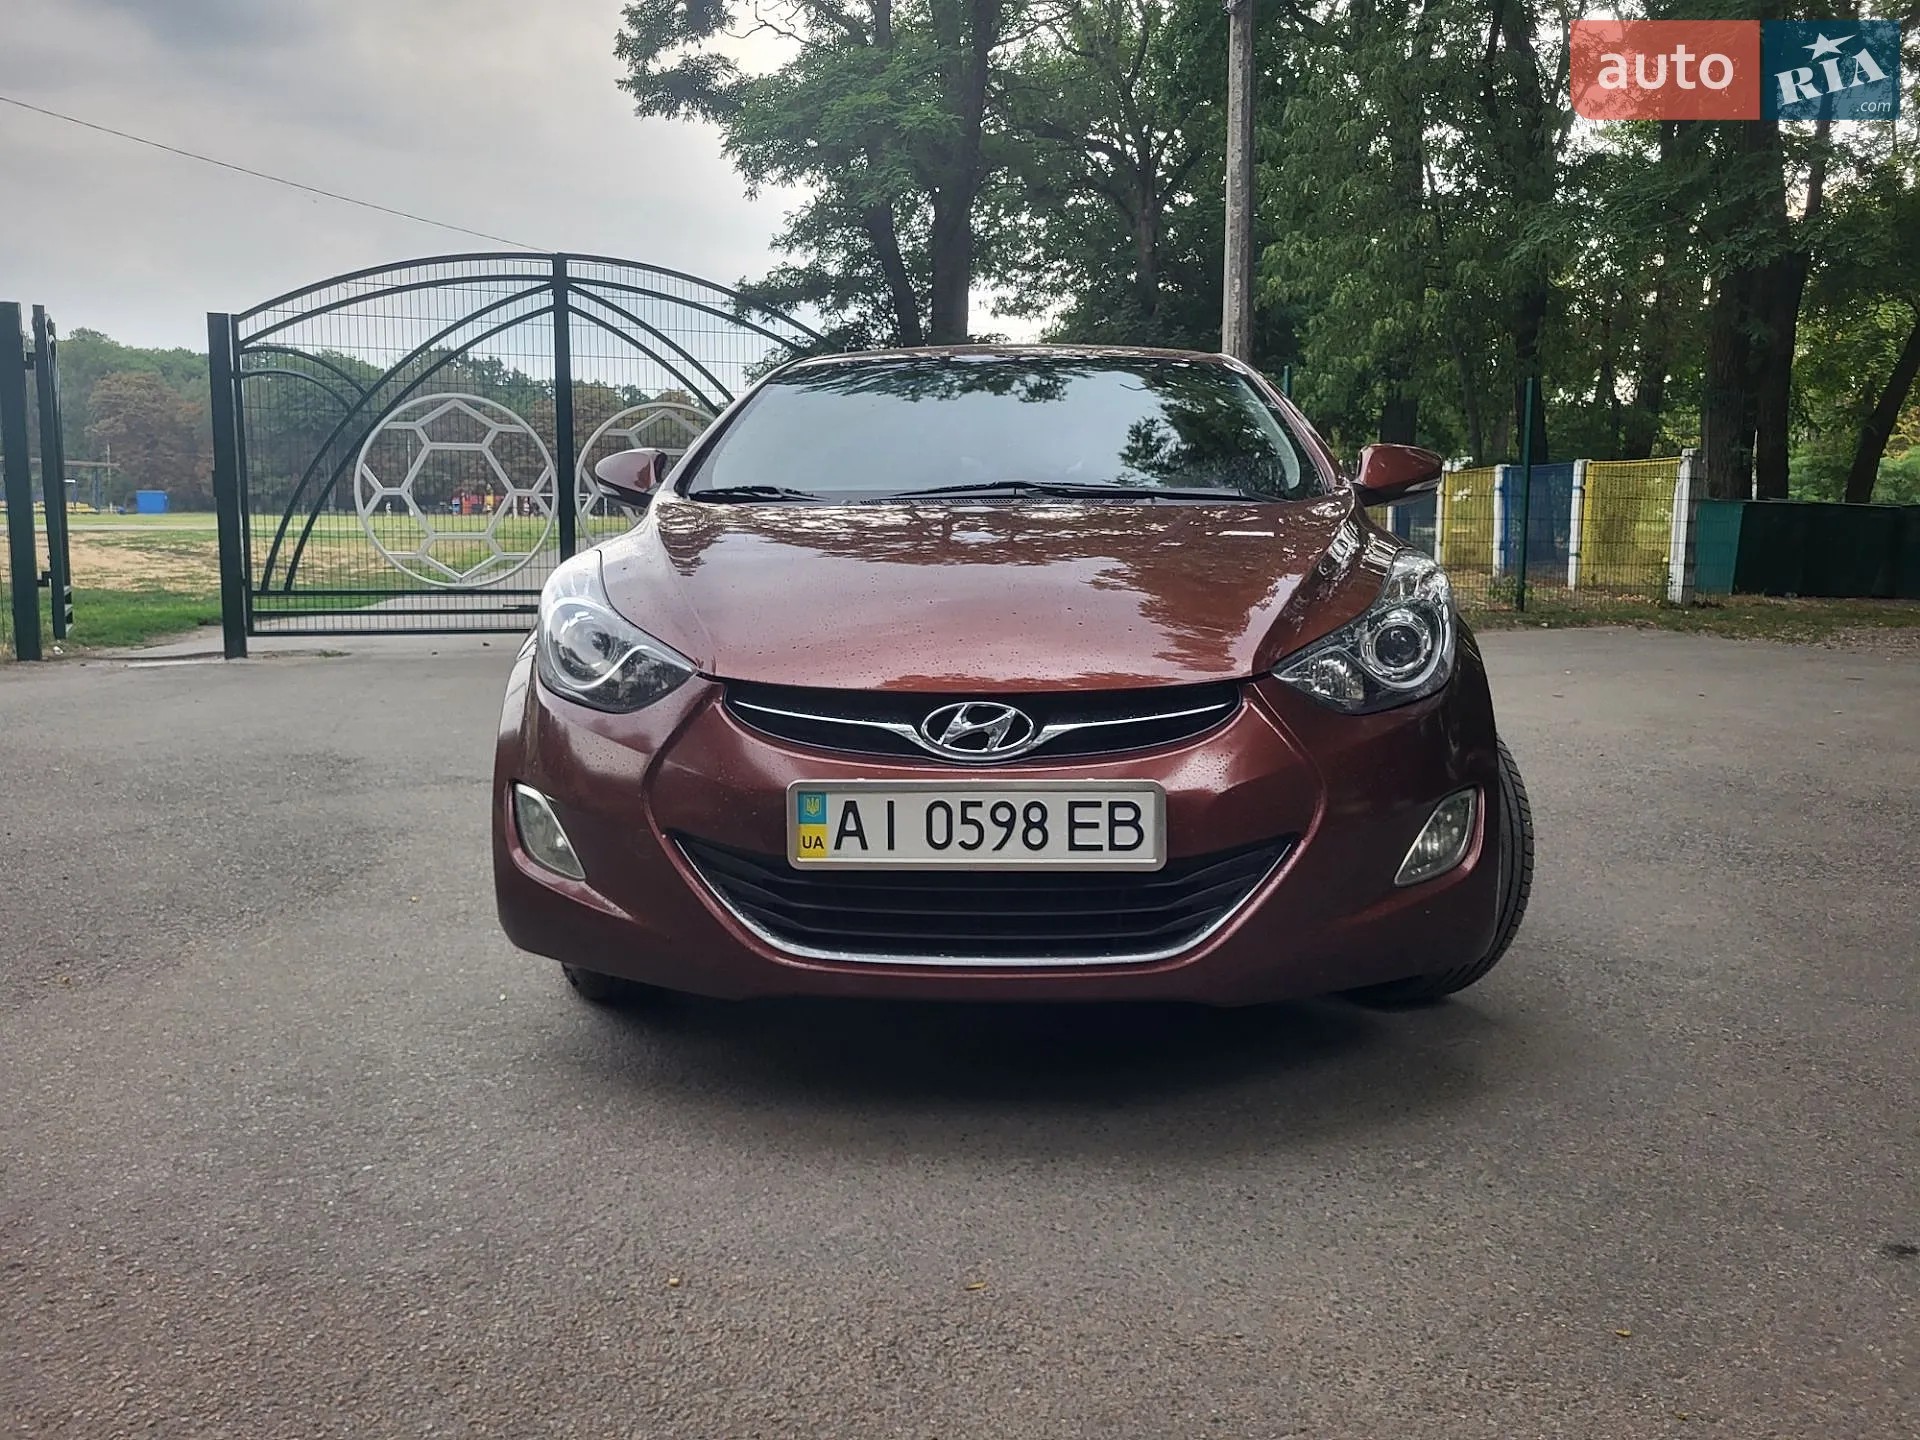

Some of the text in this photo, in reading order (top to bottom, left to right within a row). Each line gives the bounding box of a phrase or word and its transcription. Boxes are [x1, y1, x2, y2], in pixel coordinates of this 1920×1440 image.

[833, 800, 1145, 851] AI 0598 EB
[802, 835, 825, 849] UA
